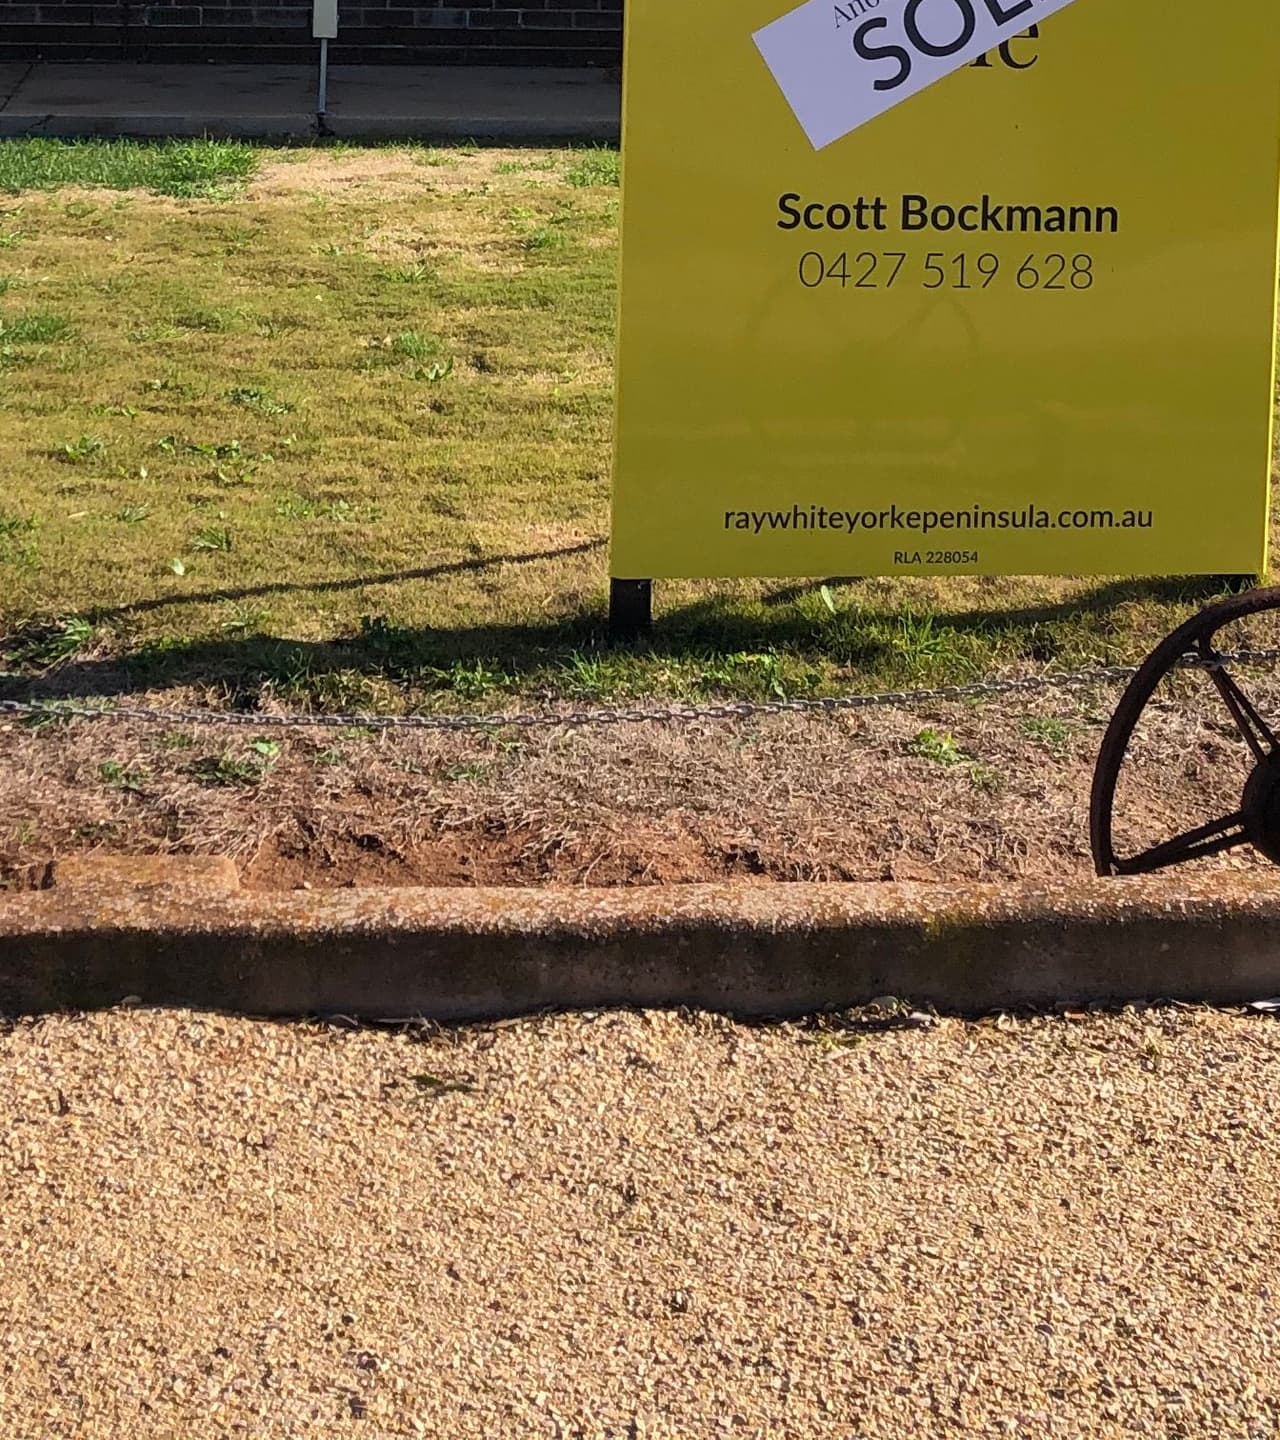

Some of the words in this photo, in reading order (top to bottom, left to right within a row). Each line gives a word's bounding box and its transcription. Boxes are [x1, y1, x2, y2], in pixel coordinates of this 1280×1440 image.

[776, 192, 888, 231] Scott
[901, 194, 1118, 233] Bockmann
[798, 251, 907, 289] 0427
[922, 252, 1000, 290] 519
[1016, 253, 1093, 291] 628
[724, 503, 1153, 535] raywhiteyorkepeninsula.com.au
[894, 551, 922, 564] RLA
[925, 551, 978, 564] 228054
